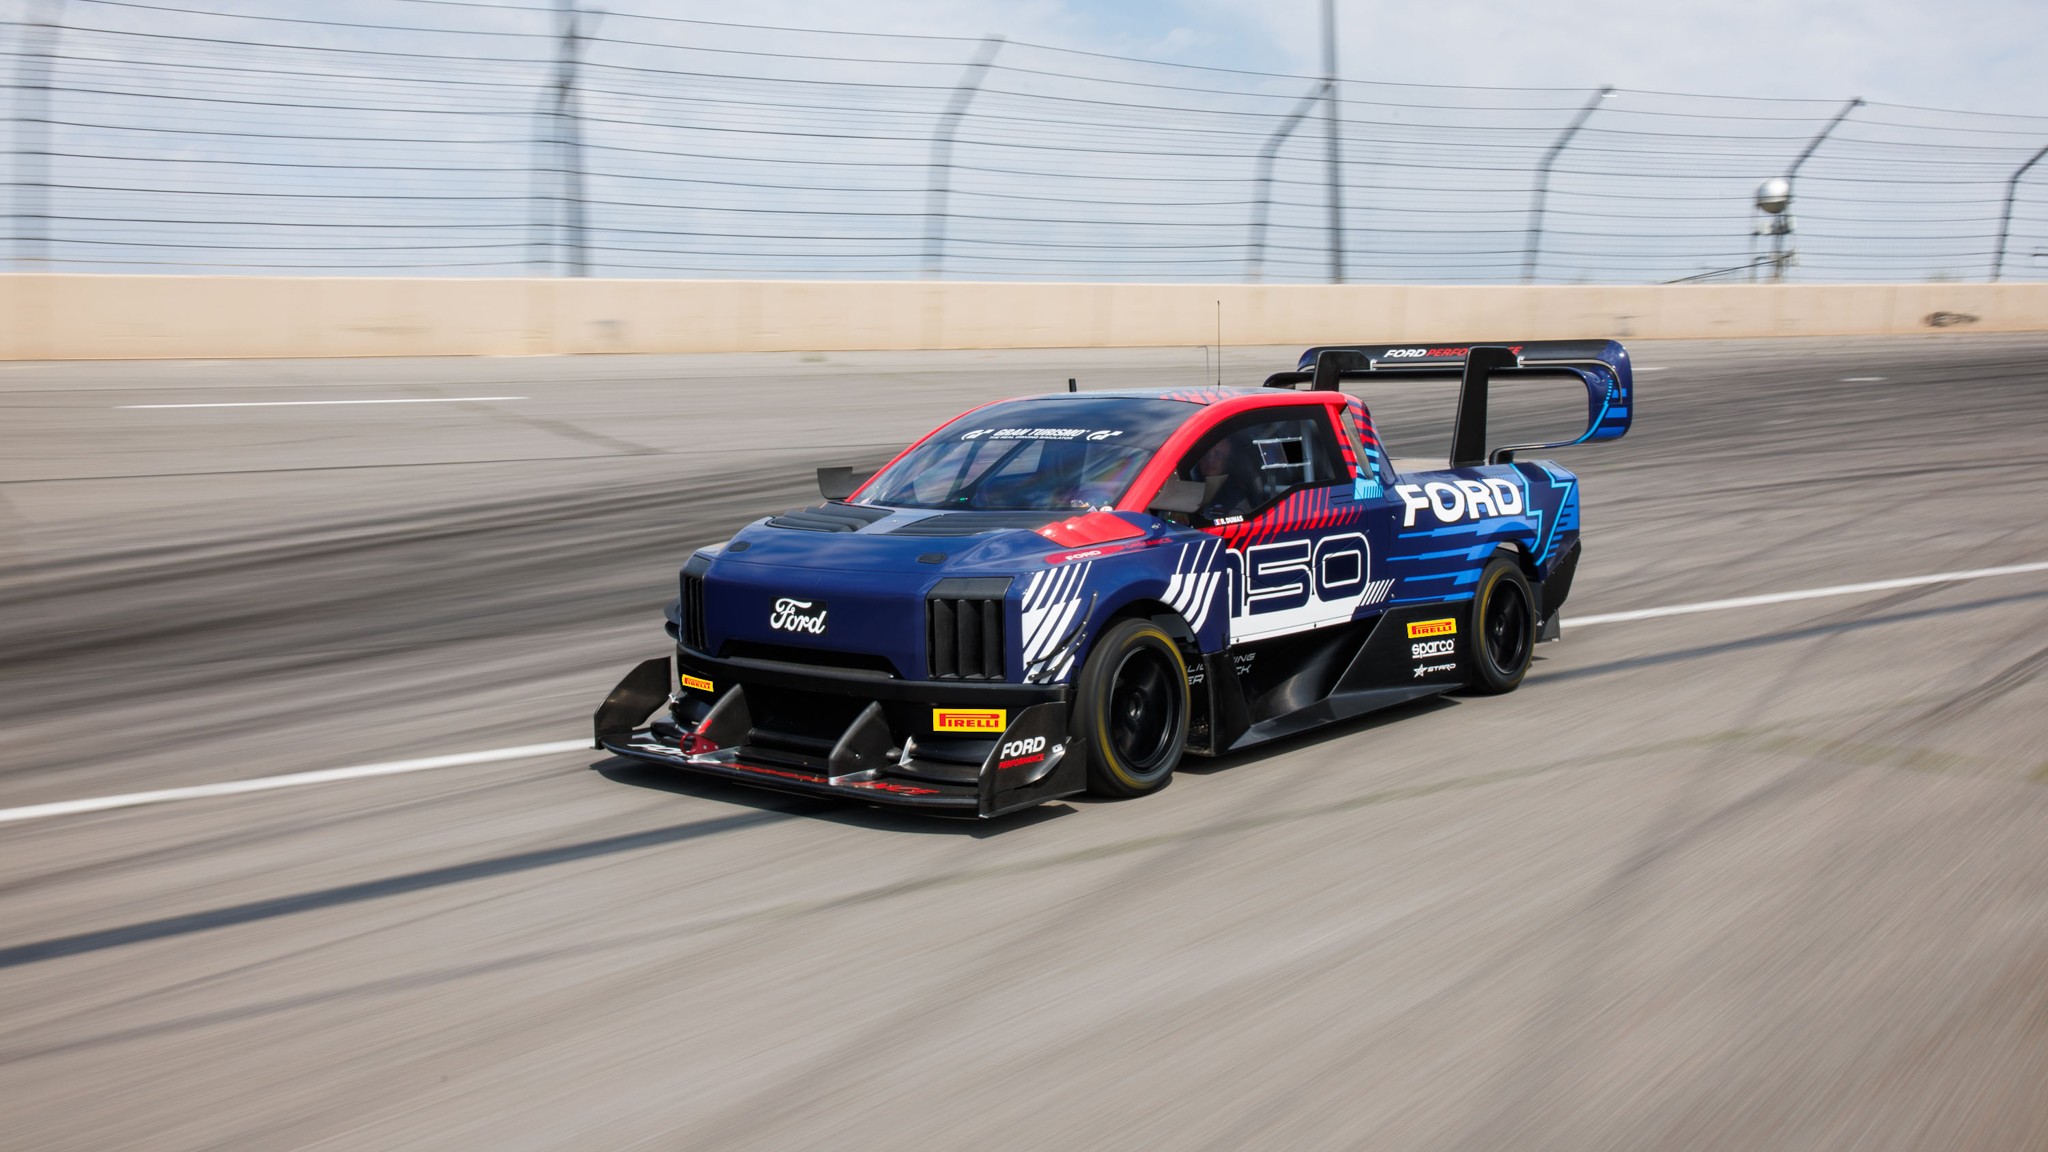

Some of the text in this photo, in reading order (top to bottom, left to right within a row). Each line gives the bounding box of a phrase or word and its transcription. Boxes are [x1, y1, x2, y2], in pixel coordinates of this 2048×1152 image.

[1384, 346, 1524, 358] FORD PERFOE
[993, 428, 1032, 437] GRAN
[1398, 478, 1522, 527] FORD
[1065, 550, 1102, 560] FORD
[770, 598, 827, 634] Ford
[1412, 622, 1452, 635] PIRELLI
[1412, 639, 1454, 659] sparco
[684, 677, 711, 689] PIRELLI
[939, 713, 1000, 728] PIRELLI
[1000, 736, 1046, 759] FORD
[998, 753, 1045, 770] PERFORMANCE
